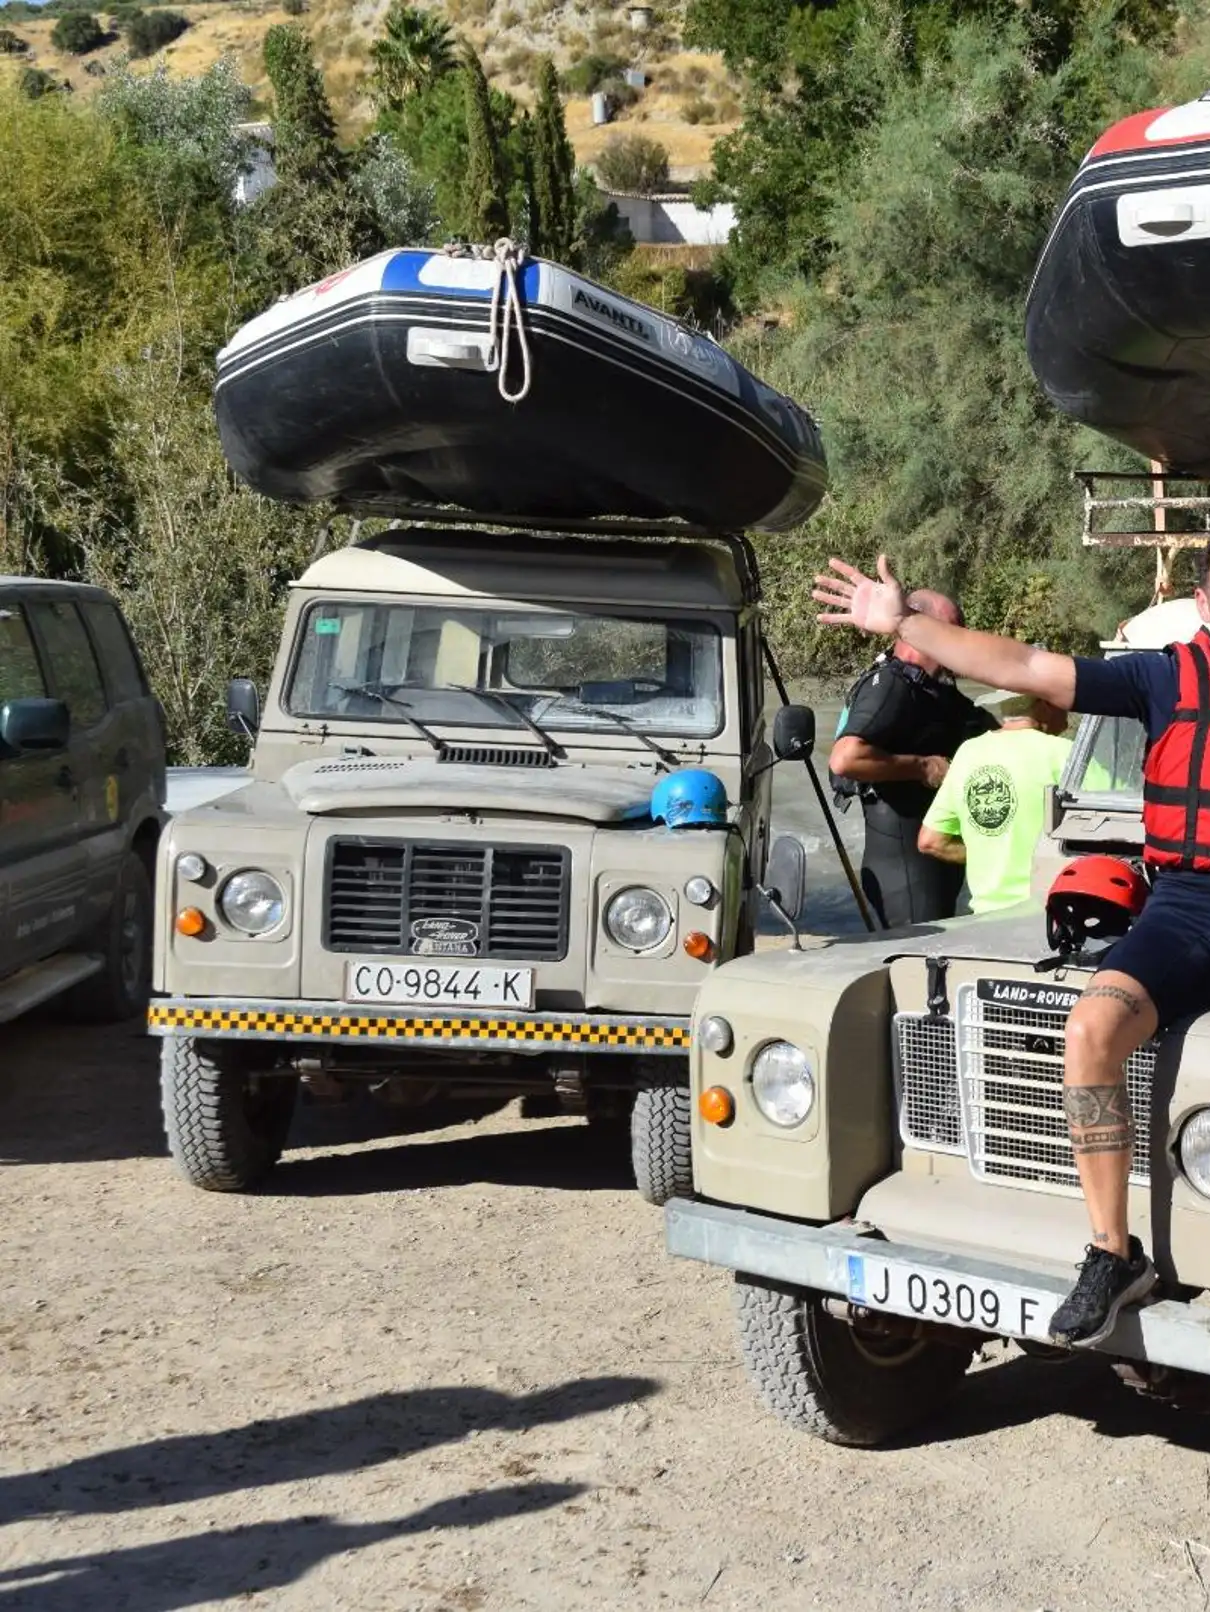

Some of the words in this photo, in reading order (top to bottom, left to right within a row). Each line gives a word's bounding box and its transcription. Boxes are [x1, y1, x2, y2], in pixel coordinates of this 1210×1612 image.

[574, 289, 643, 334] AVANTI
[872, 1267, 890, 1304] J
[907, 1273, 1000, 1328] 0309
[1020, 1297, 1039, 1335] F
